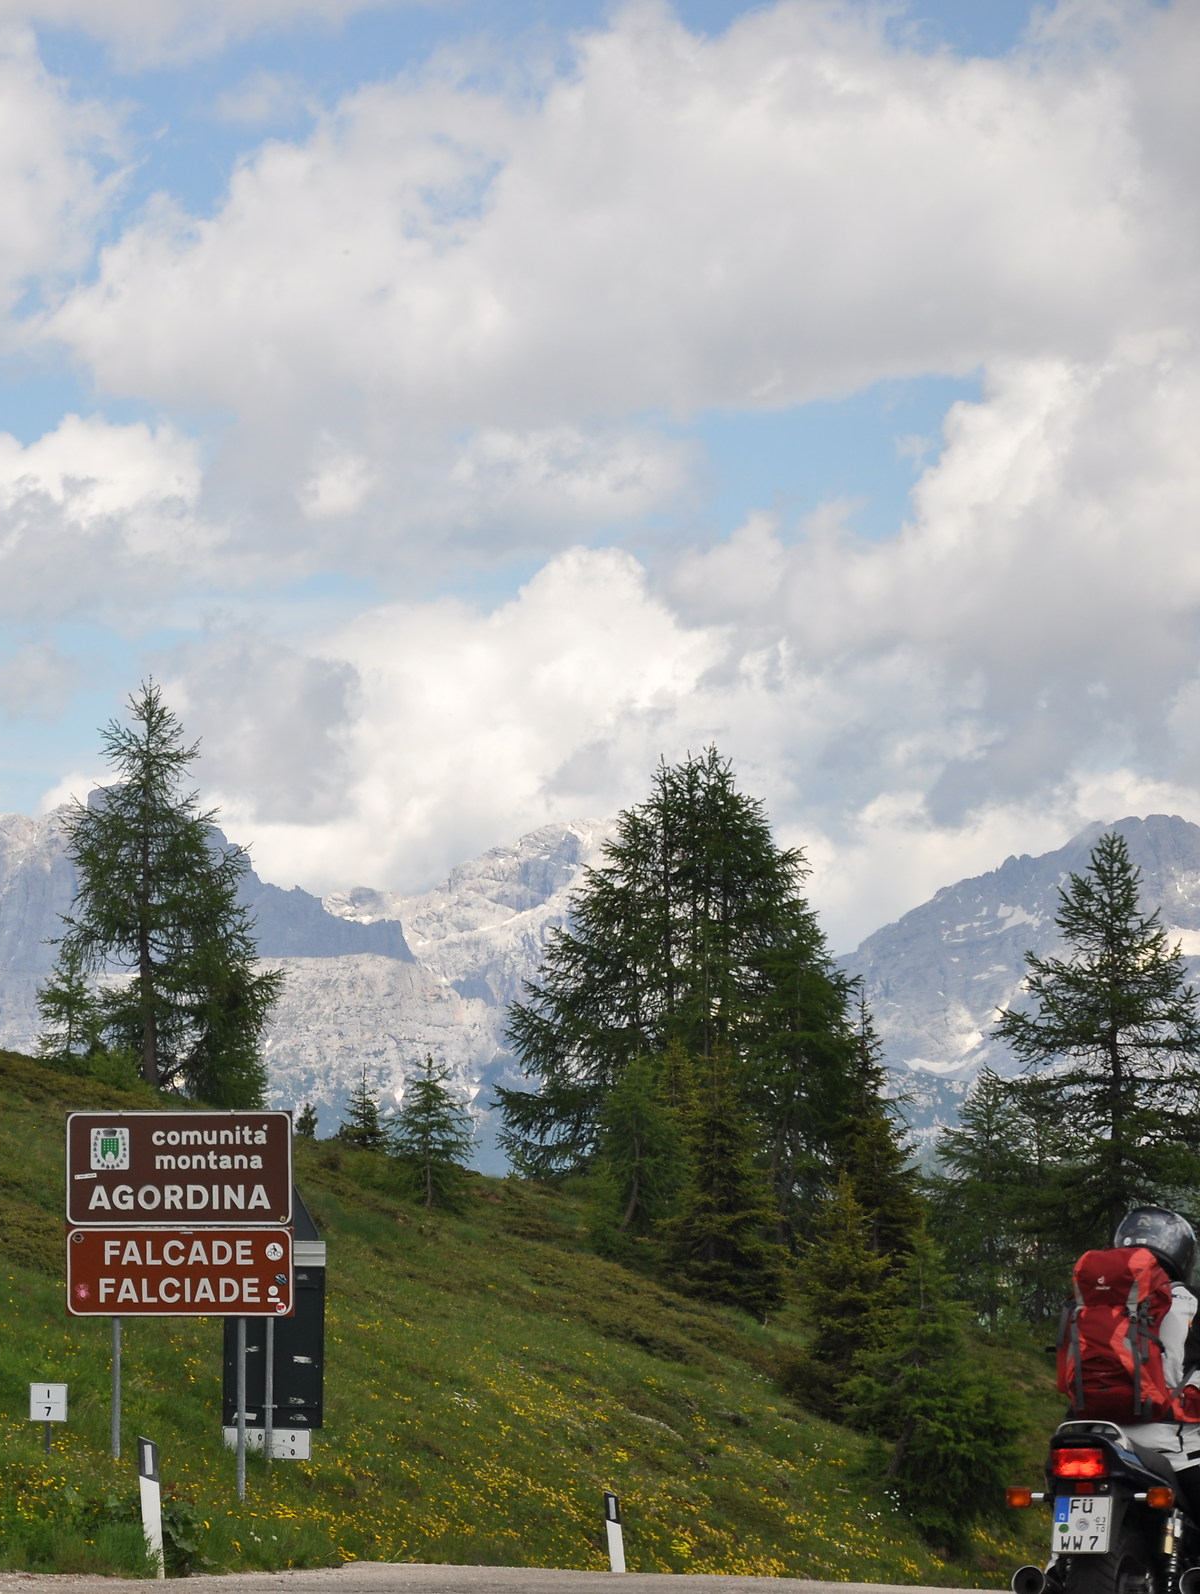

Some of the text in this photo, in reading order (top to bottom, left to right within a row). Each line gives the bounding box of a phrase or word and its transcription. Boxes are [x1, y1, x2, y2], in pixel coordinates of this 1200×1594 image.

[155, 1150, 263, 1170] montana
[88, 1184, 272, 1211] AGORDINA
[104, 1240, 254, 1266] FALCADE
[98, 1277, 261, 1304] FALCIADE
[44, 1406, 52, 1417] 7
[1070, 1498, 1093, 1514] FÜ
[1061, 1536, 1099, 1551] WW 7
